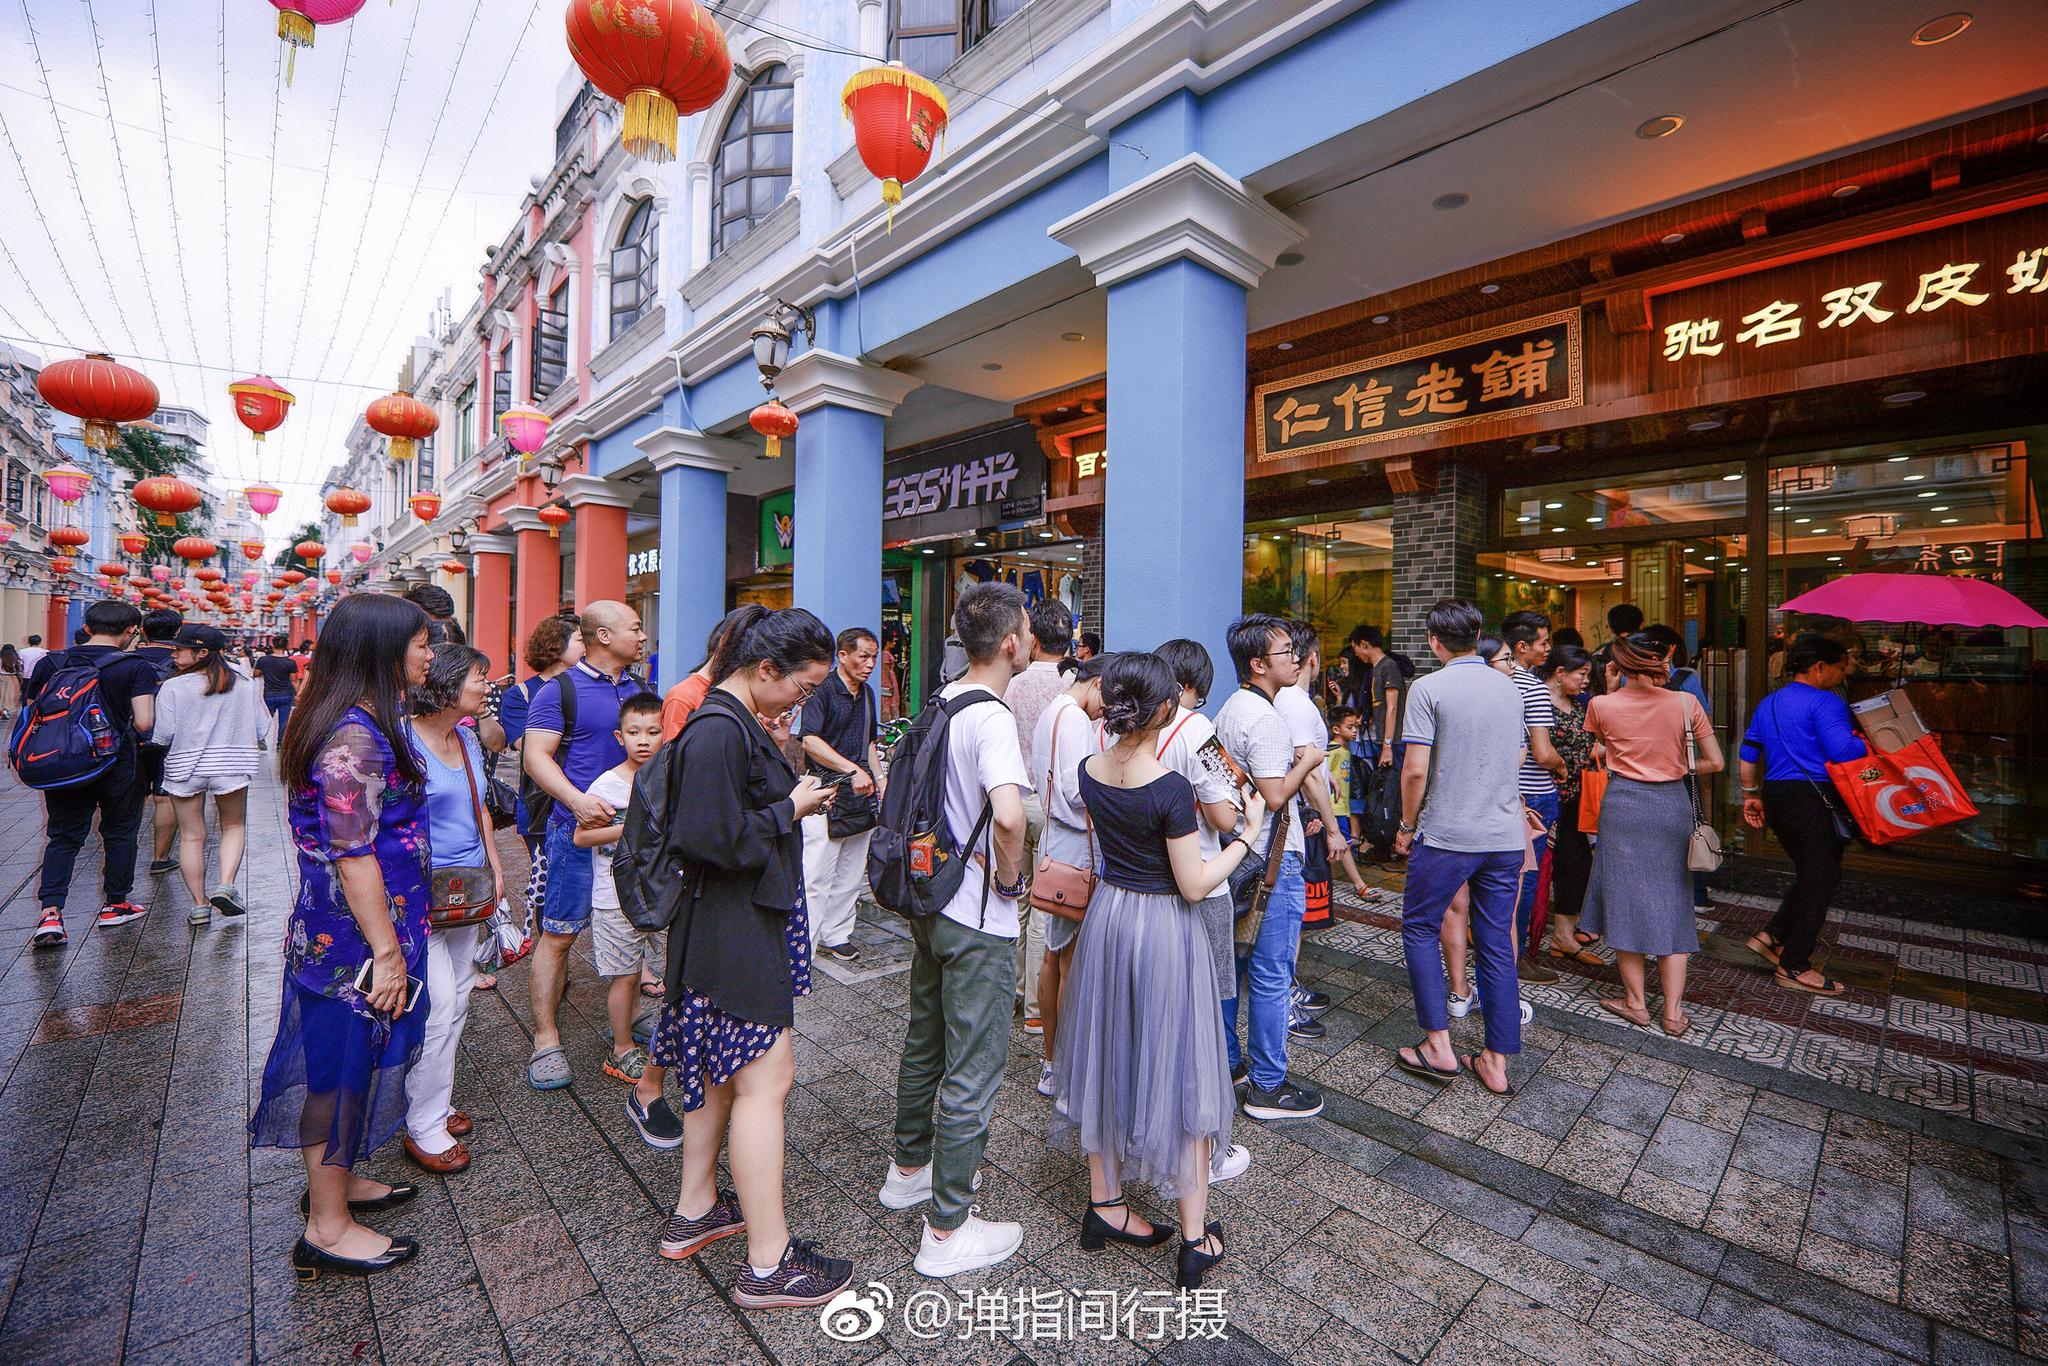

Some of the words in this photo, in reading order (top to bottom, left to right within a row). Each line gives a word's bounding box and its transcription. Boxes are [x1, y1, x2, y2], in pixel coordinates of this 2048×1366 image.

[1075, 450, 1107, 479] 百
[628, 548, 661, 577] 优衣原
